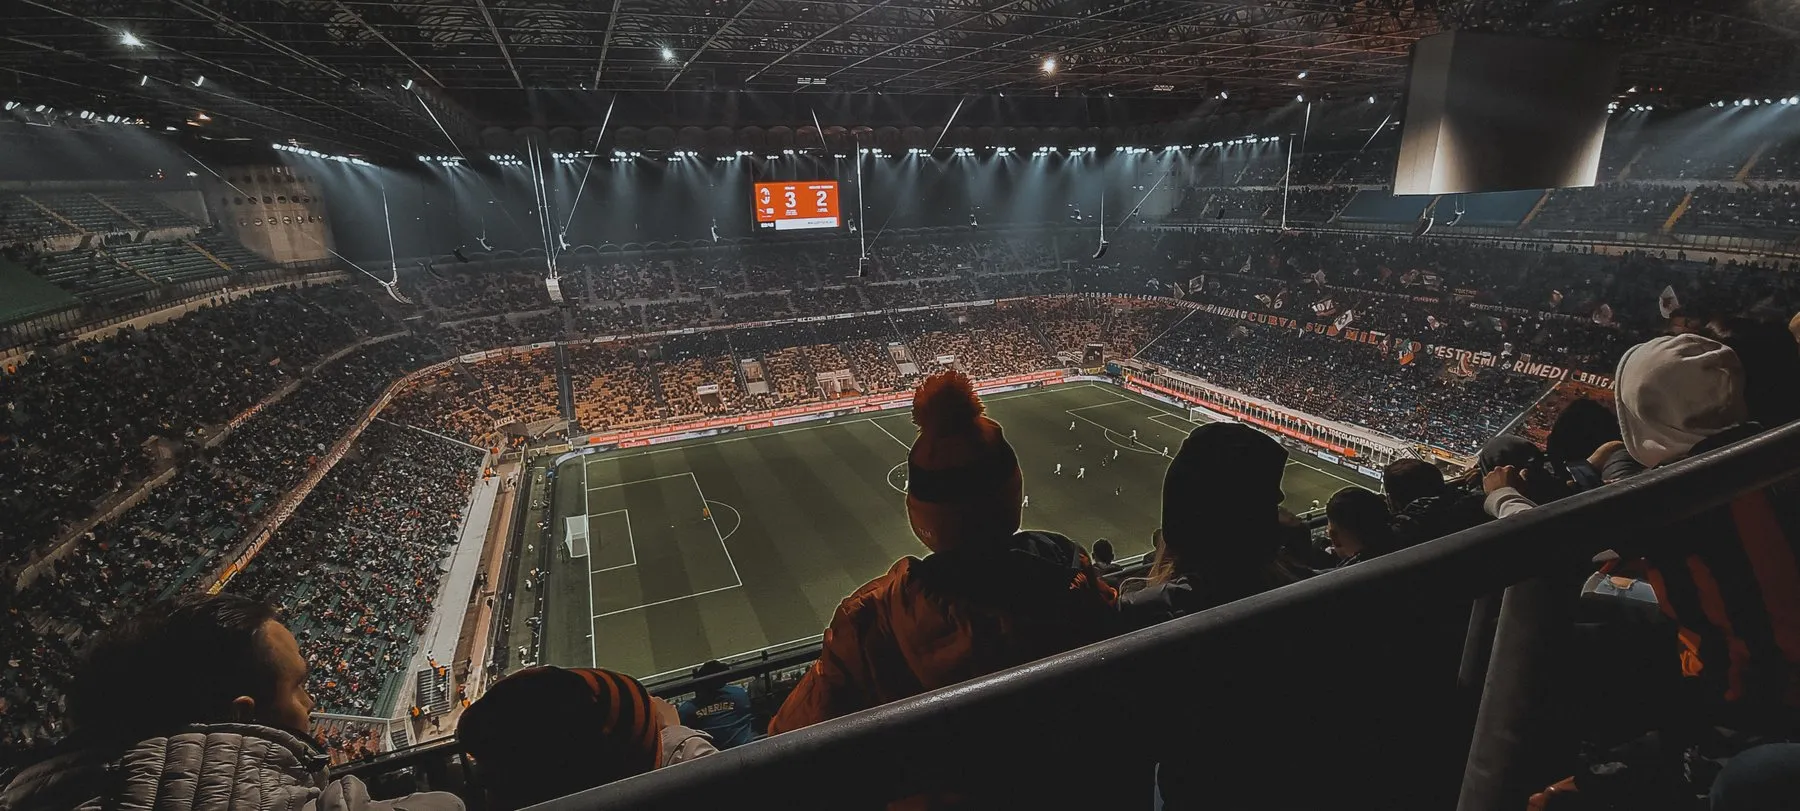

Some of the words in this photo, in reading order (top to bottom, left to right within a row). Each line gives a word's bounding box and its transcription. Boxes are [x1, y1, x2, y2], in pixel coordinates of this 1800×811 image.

[785, 192, 797, 208] 3
[816, 191, 828, 207] 2
[1247, 311, 1297, 330] CURVA
[1437, 346, 1497, 367] ESTREMI
[1512, 360, 1568, 380] RIMEDI
[695, 702, 735, 718] SVERIGE
